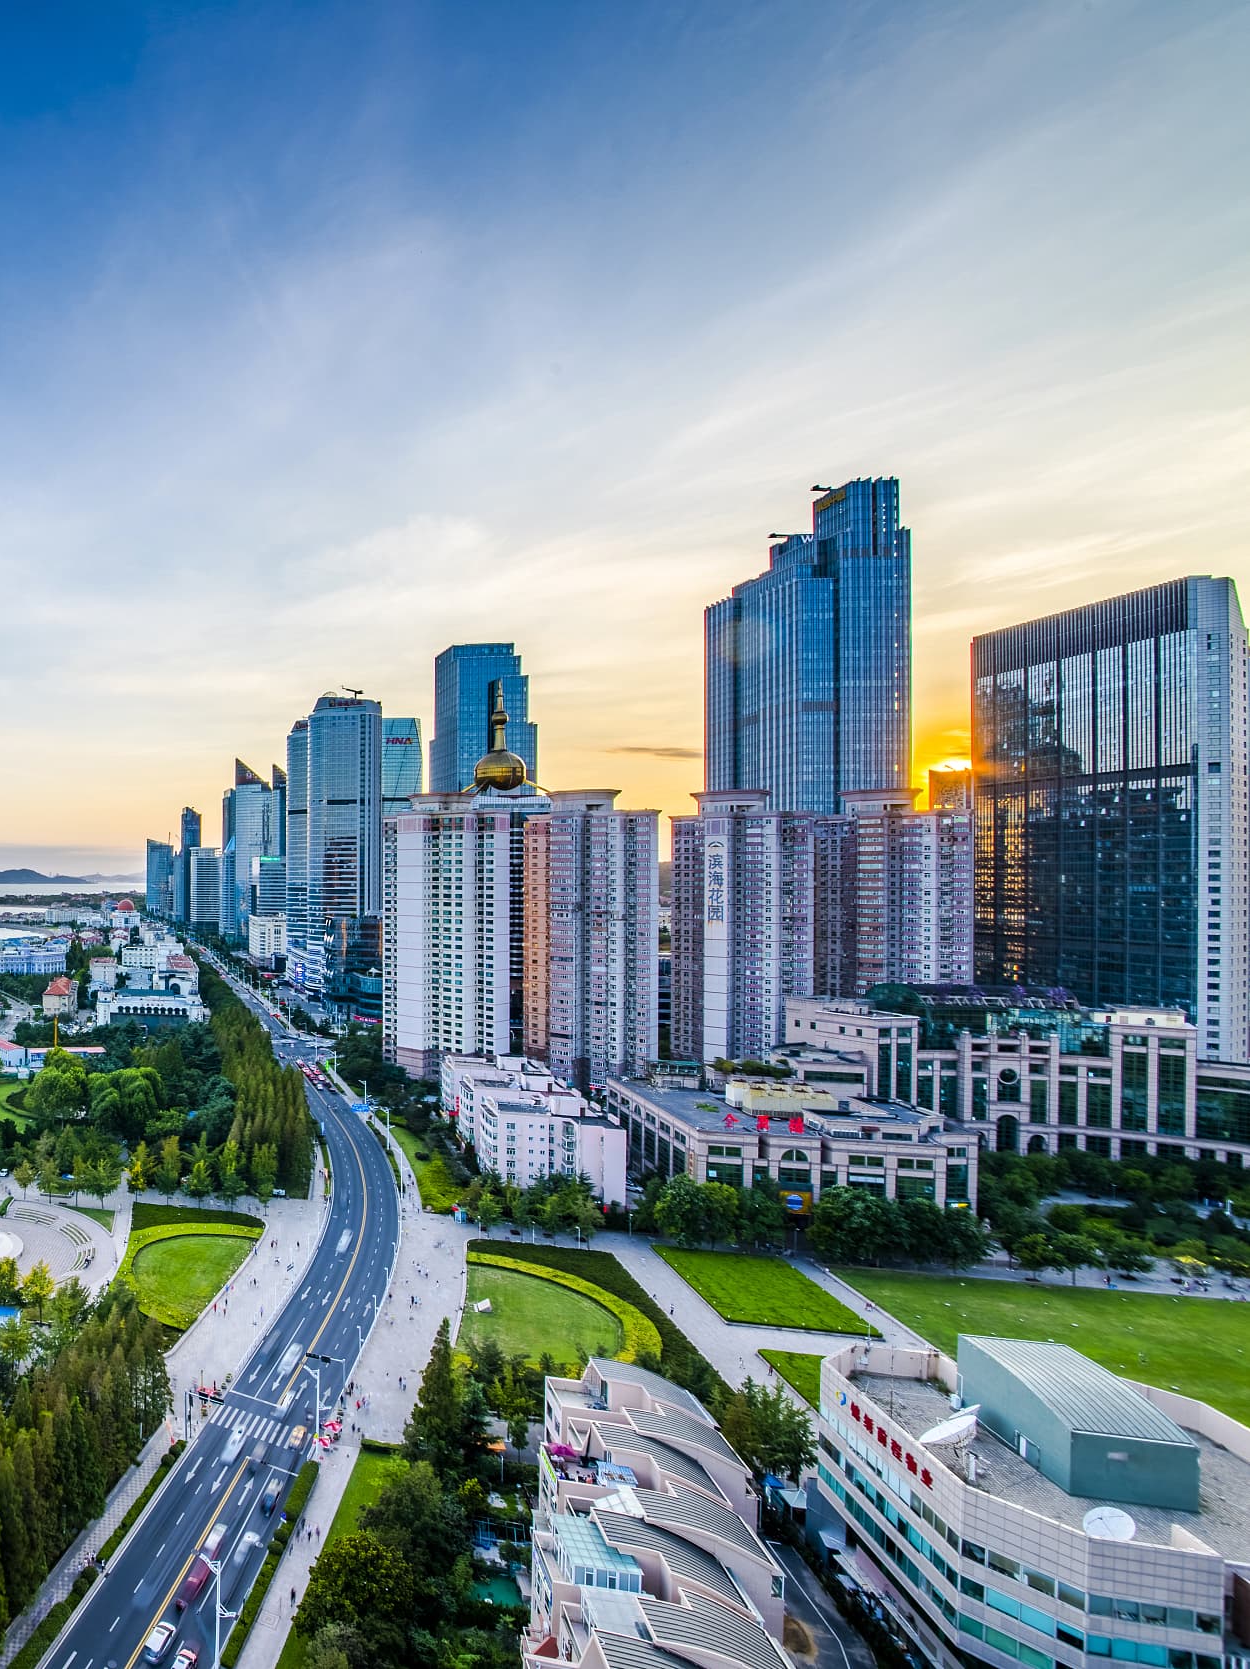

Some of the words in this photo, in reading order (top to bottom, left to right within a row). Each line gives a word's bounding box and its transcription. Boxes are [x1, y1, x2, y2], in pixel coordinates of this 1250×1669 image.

[386, 737, 413, 745] HNA
[708, 853, 725, 921] 滨海花园
